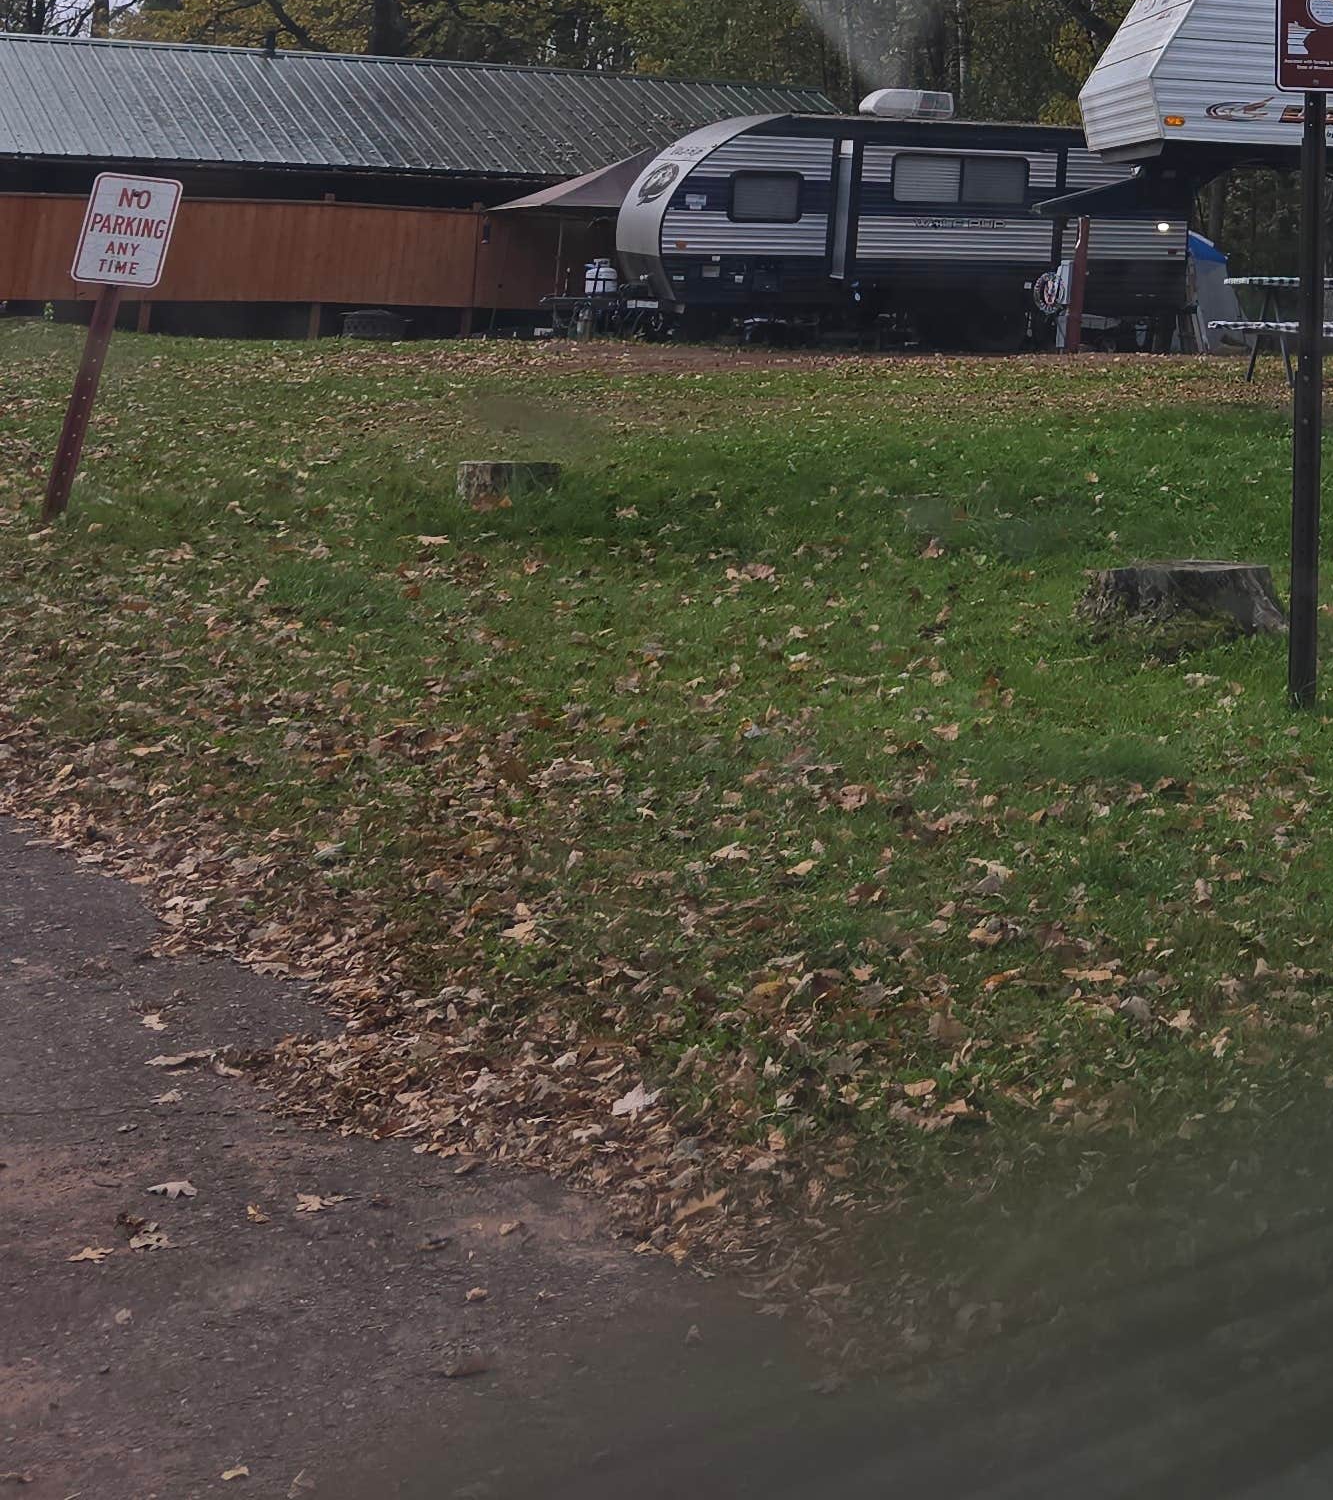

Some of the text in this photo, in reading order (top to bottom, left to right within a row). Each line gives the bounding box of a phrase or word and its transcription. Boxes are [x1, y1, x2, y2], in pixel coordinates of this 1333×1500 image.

[118, 187, 152, 210] NO
[89, 212, 167, 240] PARKING
[105, 241, 141, 257] ANY
[98, 258, 140, 276] TIME
